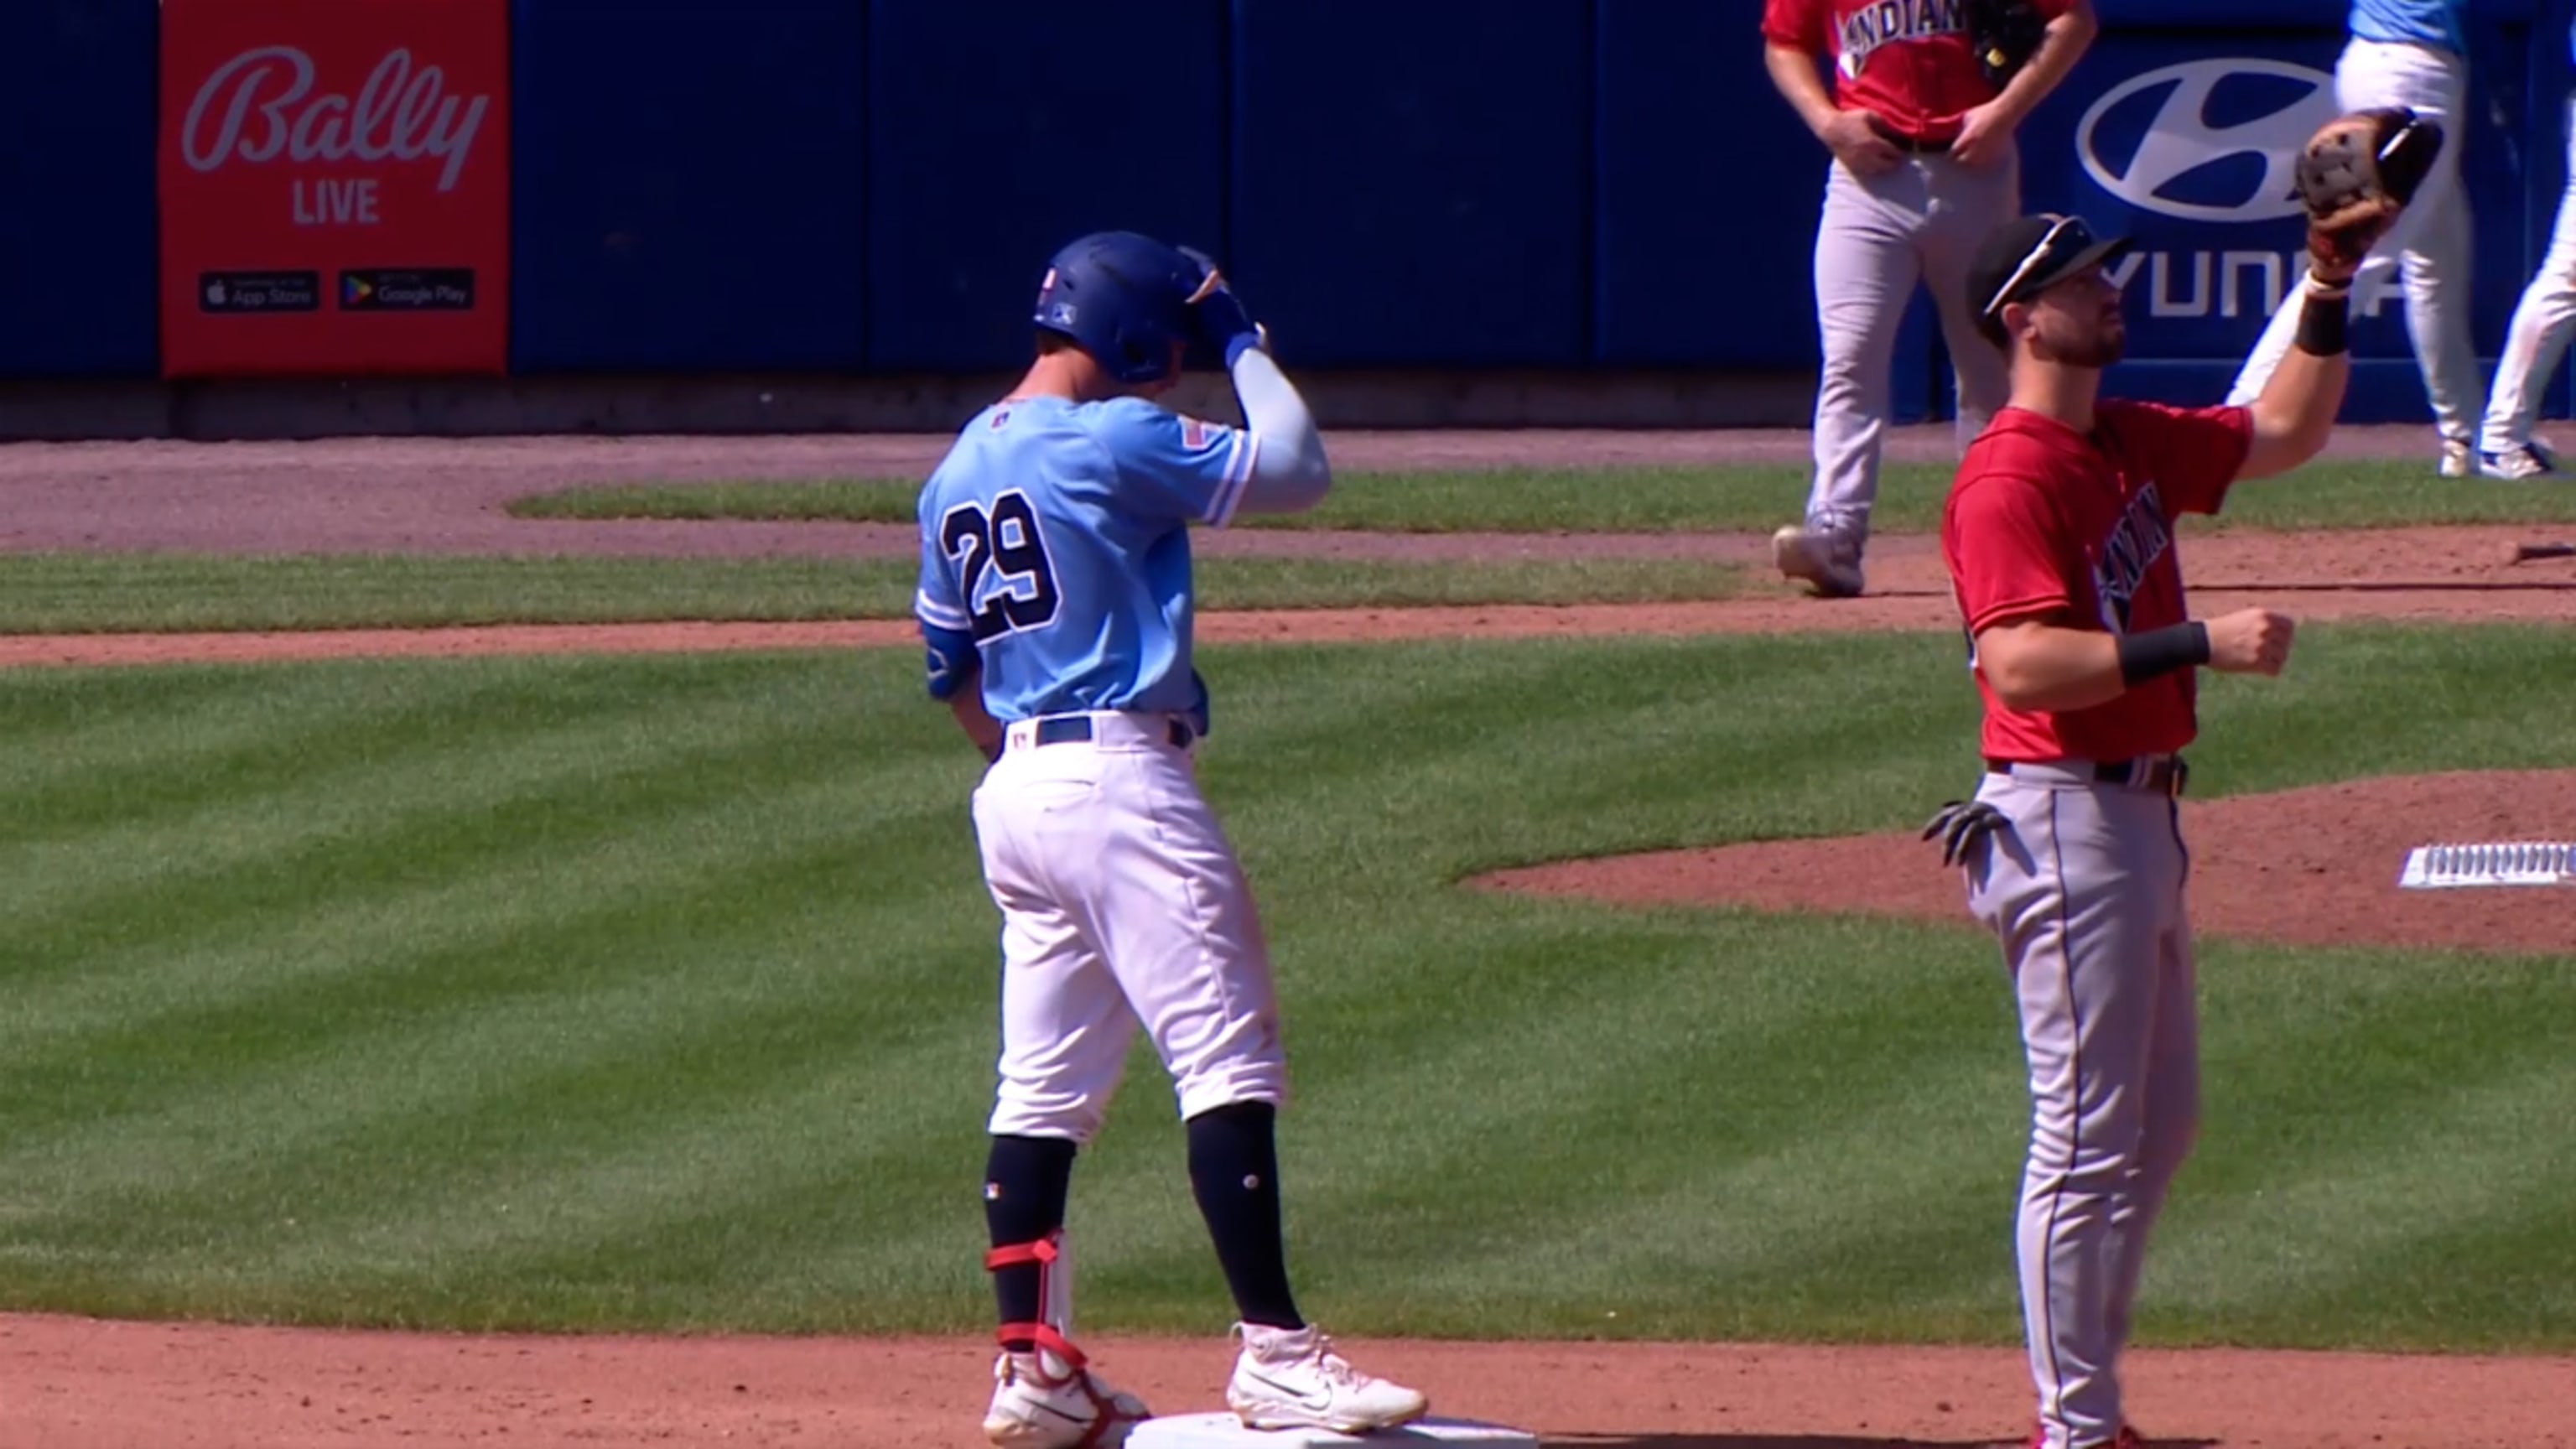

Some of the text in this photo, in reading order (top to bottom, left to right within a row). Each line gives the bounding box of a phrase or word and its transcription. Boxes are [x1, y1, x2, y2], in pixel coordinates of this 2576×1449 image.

[182, 44, 489, 192] Bally
[293, 179, 380, 224] LIVE
[232, 288, 312, 307] App Store
[377, 284, 467, 305] Google Play
[939, 486, 1063, 647] 29
